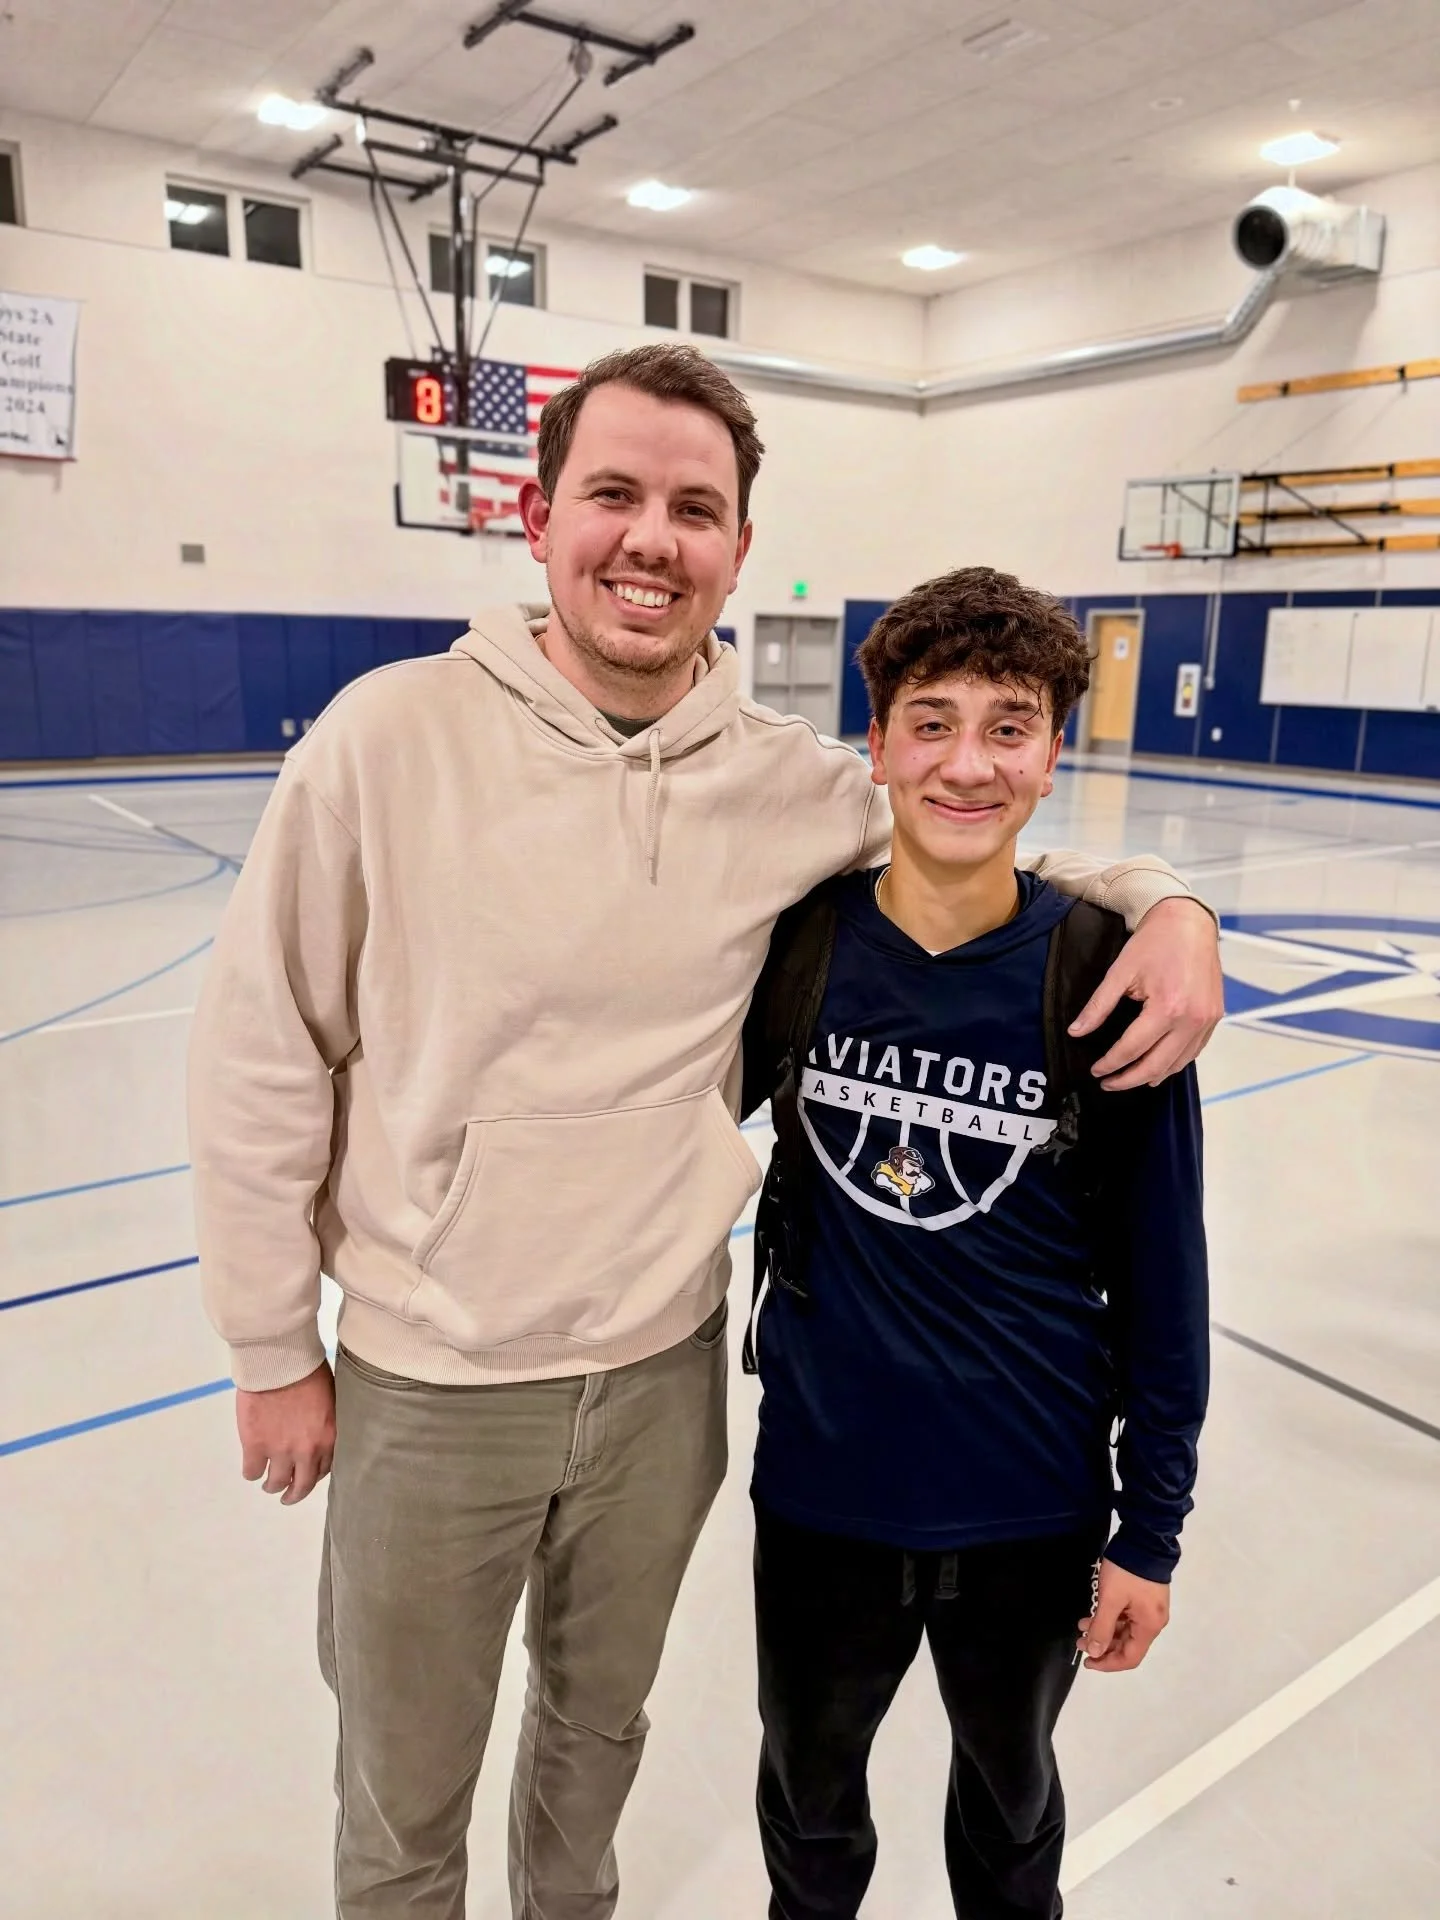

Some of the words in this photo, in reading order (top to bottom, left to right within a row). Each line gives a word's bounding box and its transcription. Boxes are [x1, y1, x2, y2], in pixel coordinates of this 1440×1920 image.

[0, 330, 42, 347] State
[1, 350, 41, 369] Golf
[5, 396, 46, 415] 2024
[415, 378, 442, 424] 8
